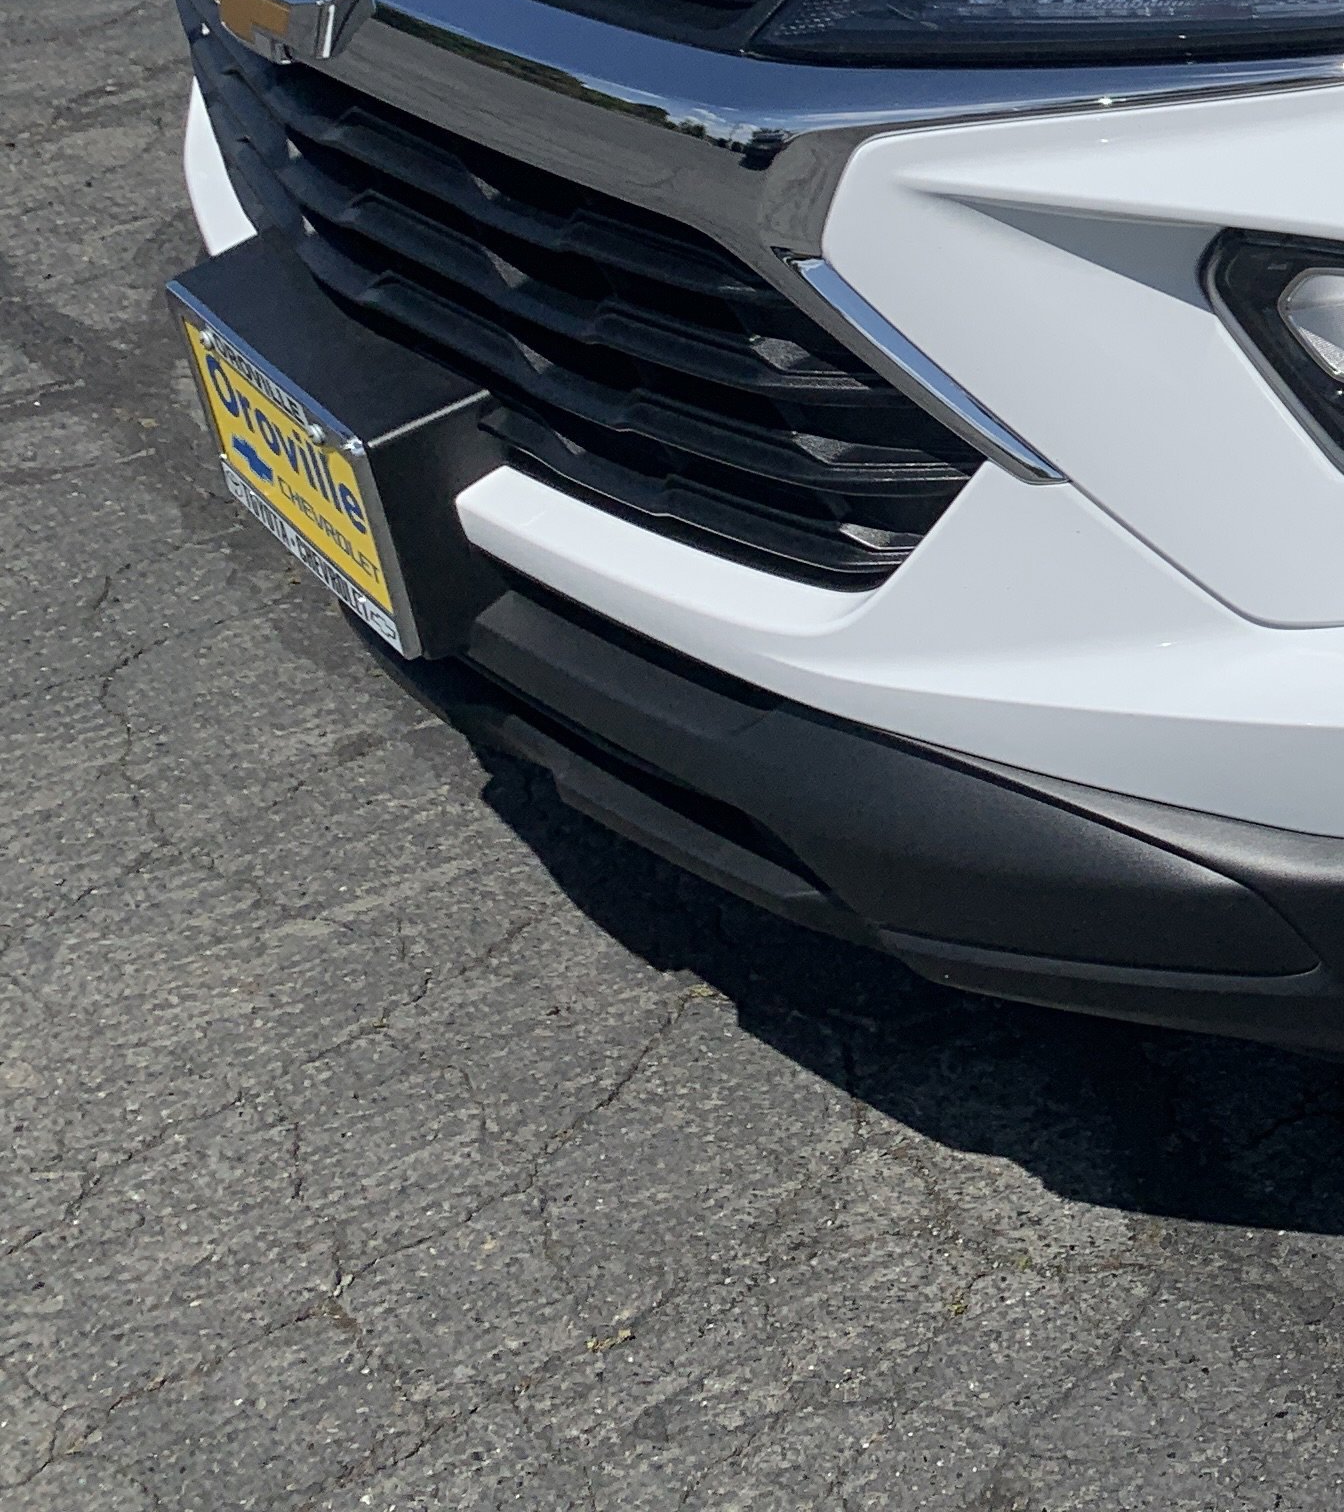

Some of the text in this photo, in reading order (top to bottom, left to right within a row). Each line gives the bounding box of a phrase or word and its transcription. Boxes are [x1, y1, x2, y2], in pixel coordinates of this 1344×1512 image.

[212, 335, 305, 424] OROVILLE
[205, 353, 367, 535] Oroville
[276, 475, 381, 584] CHEVROLET
